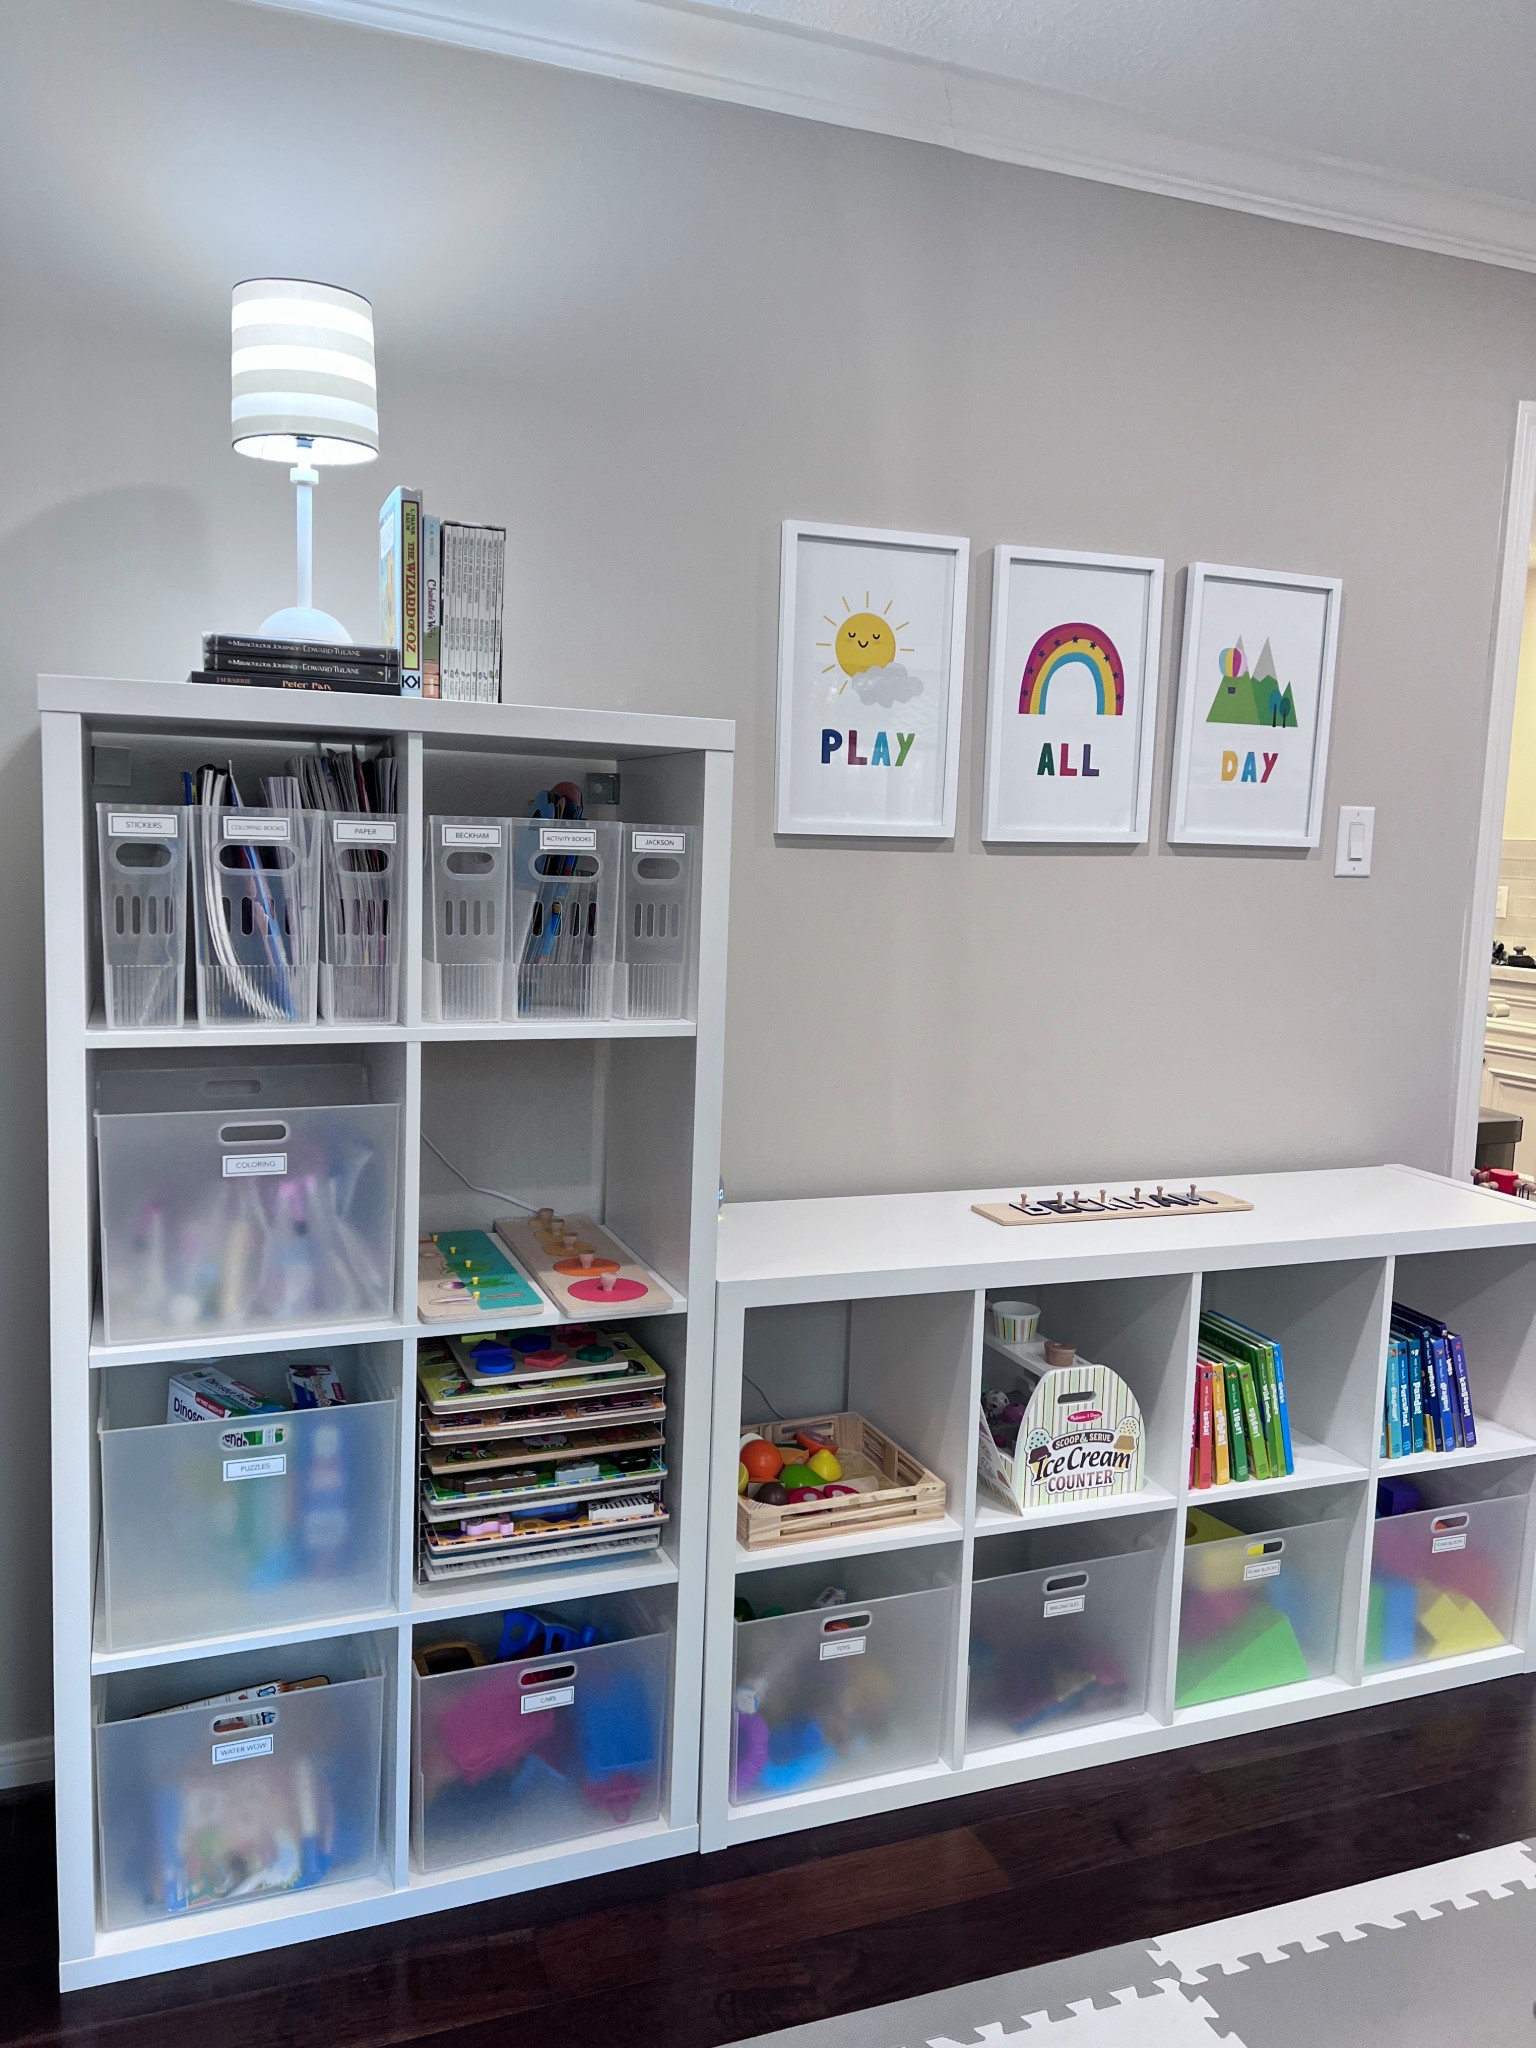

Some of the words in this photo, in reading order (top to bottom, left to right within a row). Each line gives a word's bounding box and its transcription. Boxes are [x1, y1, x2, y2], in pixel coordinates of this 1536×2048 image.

[407, 542, 415, 560] THE
[405, 562, 417, 617] WIZARD
[426, 579, 436, 620] Charlotte's
[408, 618, 416, 631] OF
[427, 618, 436, 639] Web
[302, 644, 333, 655] EDWARD
[334, 647, 361, 657] TULANE
[405, 631, 417, 654] OZ
[302, 663, 333, 673] EDWARD
[333, 665, 360, 675] TULANE
[282, 679, 309, 689] Peter
[311, 681, 332, 691] Pan
[820, 728, 916, 767] PLAY
[1037, 742, 1100, 777] ALL
[1221, 750, 1279, 784] DAY
[125, 820, 162, 829] STICKERS
[354, 828, 377, 836] PAPER
[455, 832, 490, 840] BECKHAM
[644, 839, 675, 847] JACKSON
[235, 1160, 276, 1169] COLORING
[205, 1378, 237, 1395] Dinosaur
[1440, 1383, 1449, 1412] dragon!
[1459, 1377, 1471, 1417] kangaroo!
[174, 1397, 206, 1421] Dinosa
[1055, 1436, 1080, 1449] SCOOP
[1080, 1433, 1088, 1444] &
[1089, 1433, 1111, 1442] SERVE
[240, 1463, 271, 1472] PUZZLES
[1034, 1456, 1065, 1483] Ice
[1067, 1446, 1131, 1471] Cream
[1048, 1469, 1113, 1492] COUNTER
[837, 1644, 851, 1652] TOYS
[540, 1696, 557, 1704] CARS
[220, 1745, 245, 1756] WATER
[247, 1742, 267, 1752] WOW
